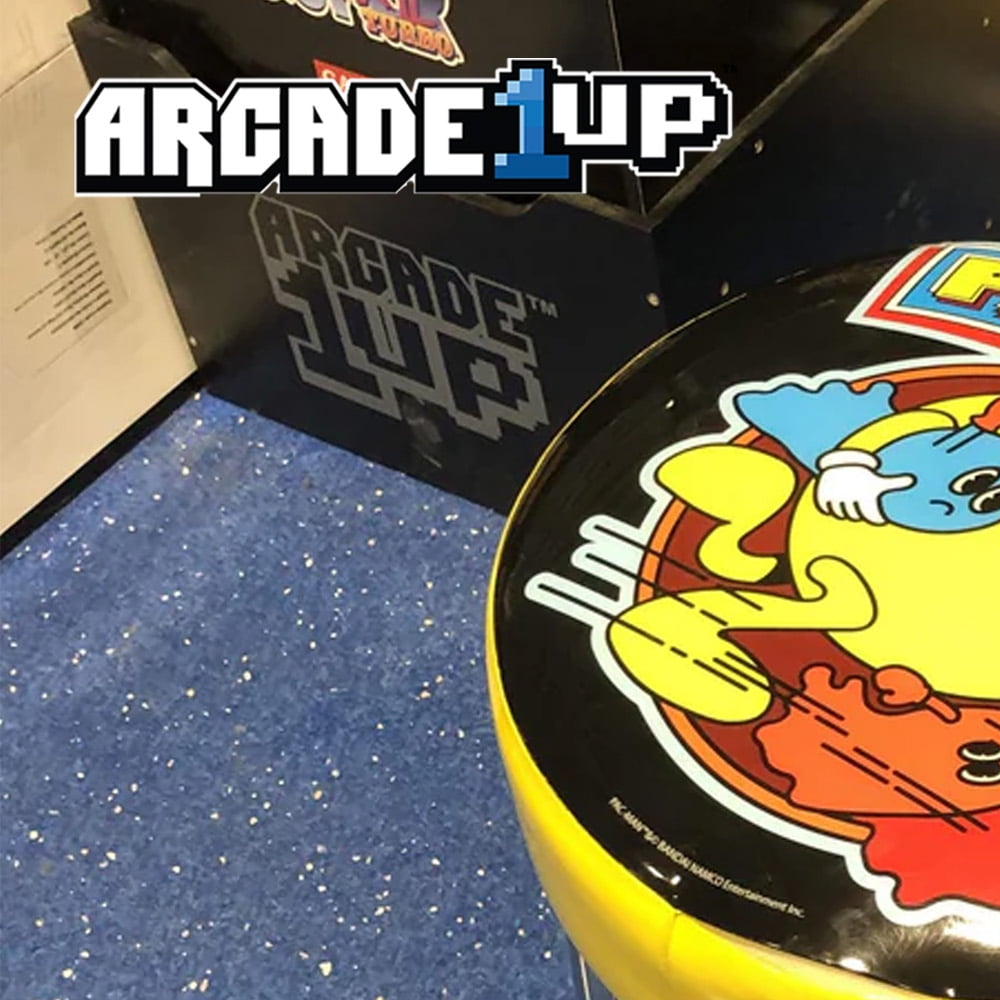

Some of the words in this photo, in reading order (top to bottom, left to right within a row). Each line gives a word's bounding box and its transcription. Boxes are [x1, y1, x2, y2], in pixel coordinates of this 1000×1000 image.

[361, 8, 457, 60] TURBO
[266, 258, 549, 441] 1UP
[688, 862, 725, 887] NAMCO
[721, 879, 789, 913] Entertainment
